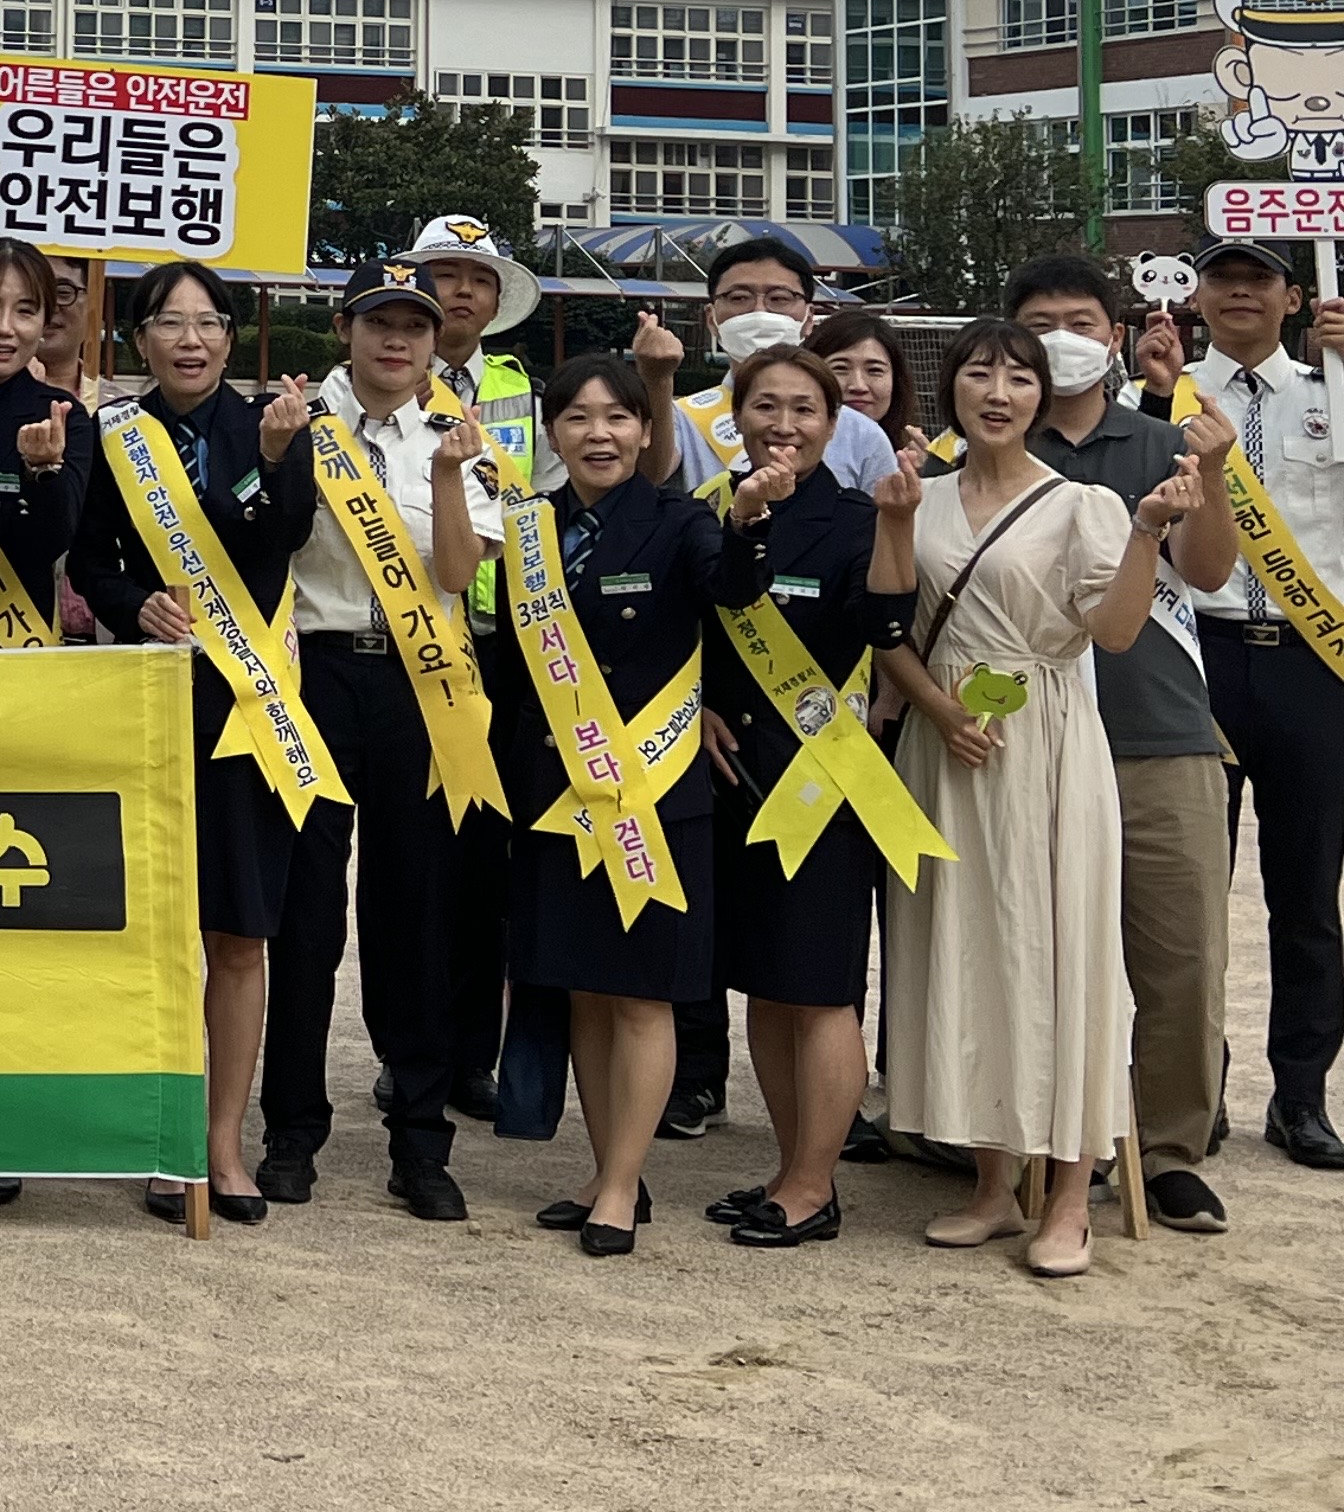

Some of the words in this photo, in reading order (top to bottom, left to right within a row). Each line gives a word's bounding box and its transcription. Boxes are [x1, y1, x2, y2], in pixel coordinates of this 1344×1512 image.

[126, 74, 248, 119] 안전운전
[1, 108, 227, 181] 우리들은
[0, 172, 223, 246] 안전보행
[313, 424, 361, 481] 함께
[345, 491, 418, 593] 만들어
[1224, 465, 1273, 541] 전한
[120, 426, 159, 483] 보행자
[145, 486, 181, 533] 안전
[168, 531, 205, 576] 우선
[192, 575, 281, 700] 거제경찰서와
[515, 509, 549, 594] 안전보행
[517, 587, 567, 629] 3원칙
[538, 622, 580, 689] 서다
[575, 720, 621, 783] 보다
[613, 817, 656, 886] 걷다
